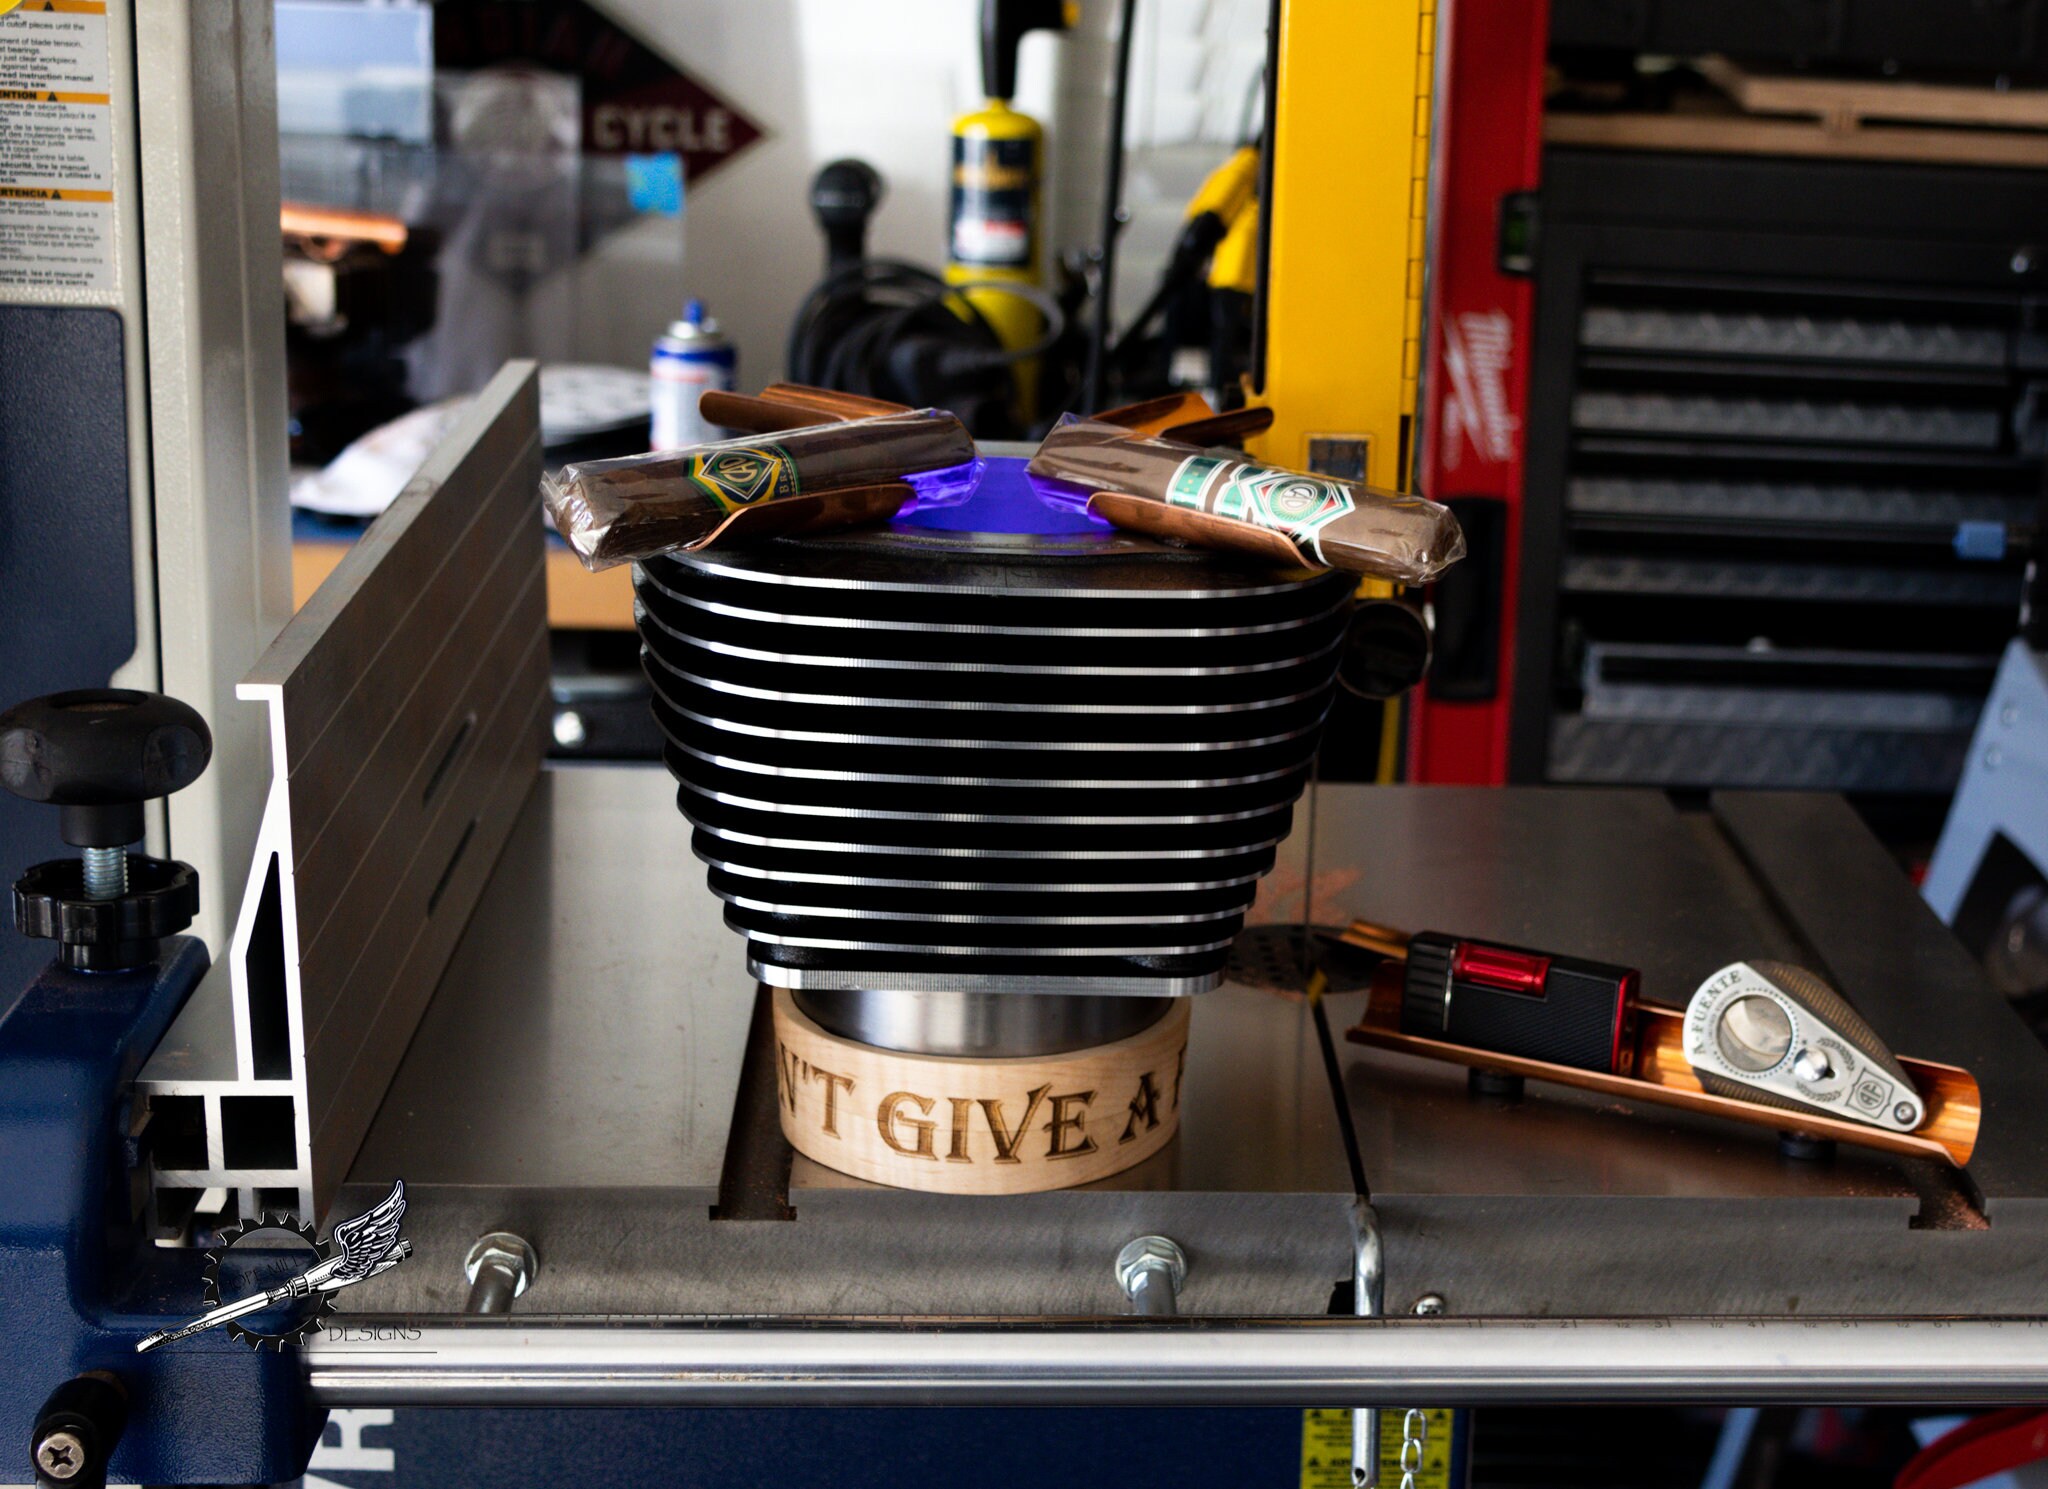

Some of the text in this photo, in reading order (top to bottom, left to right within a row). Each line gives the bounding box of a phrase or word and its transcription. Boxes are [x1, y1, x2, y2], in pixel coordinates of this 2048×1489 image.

[594, 103, 731, 150] CYCLE
[1691, 969, 1742, 1033] FUENTE
[877, 1082, 1100, 1165] GIVE
[1118, 1071, 1161, 1145] A
